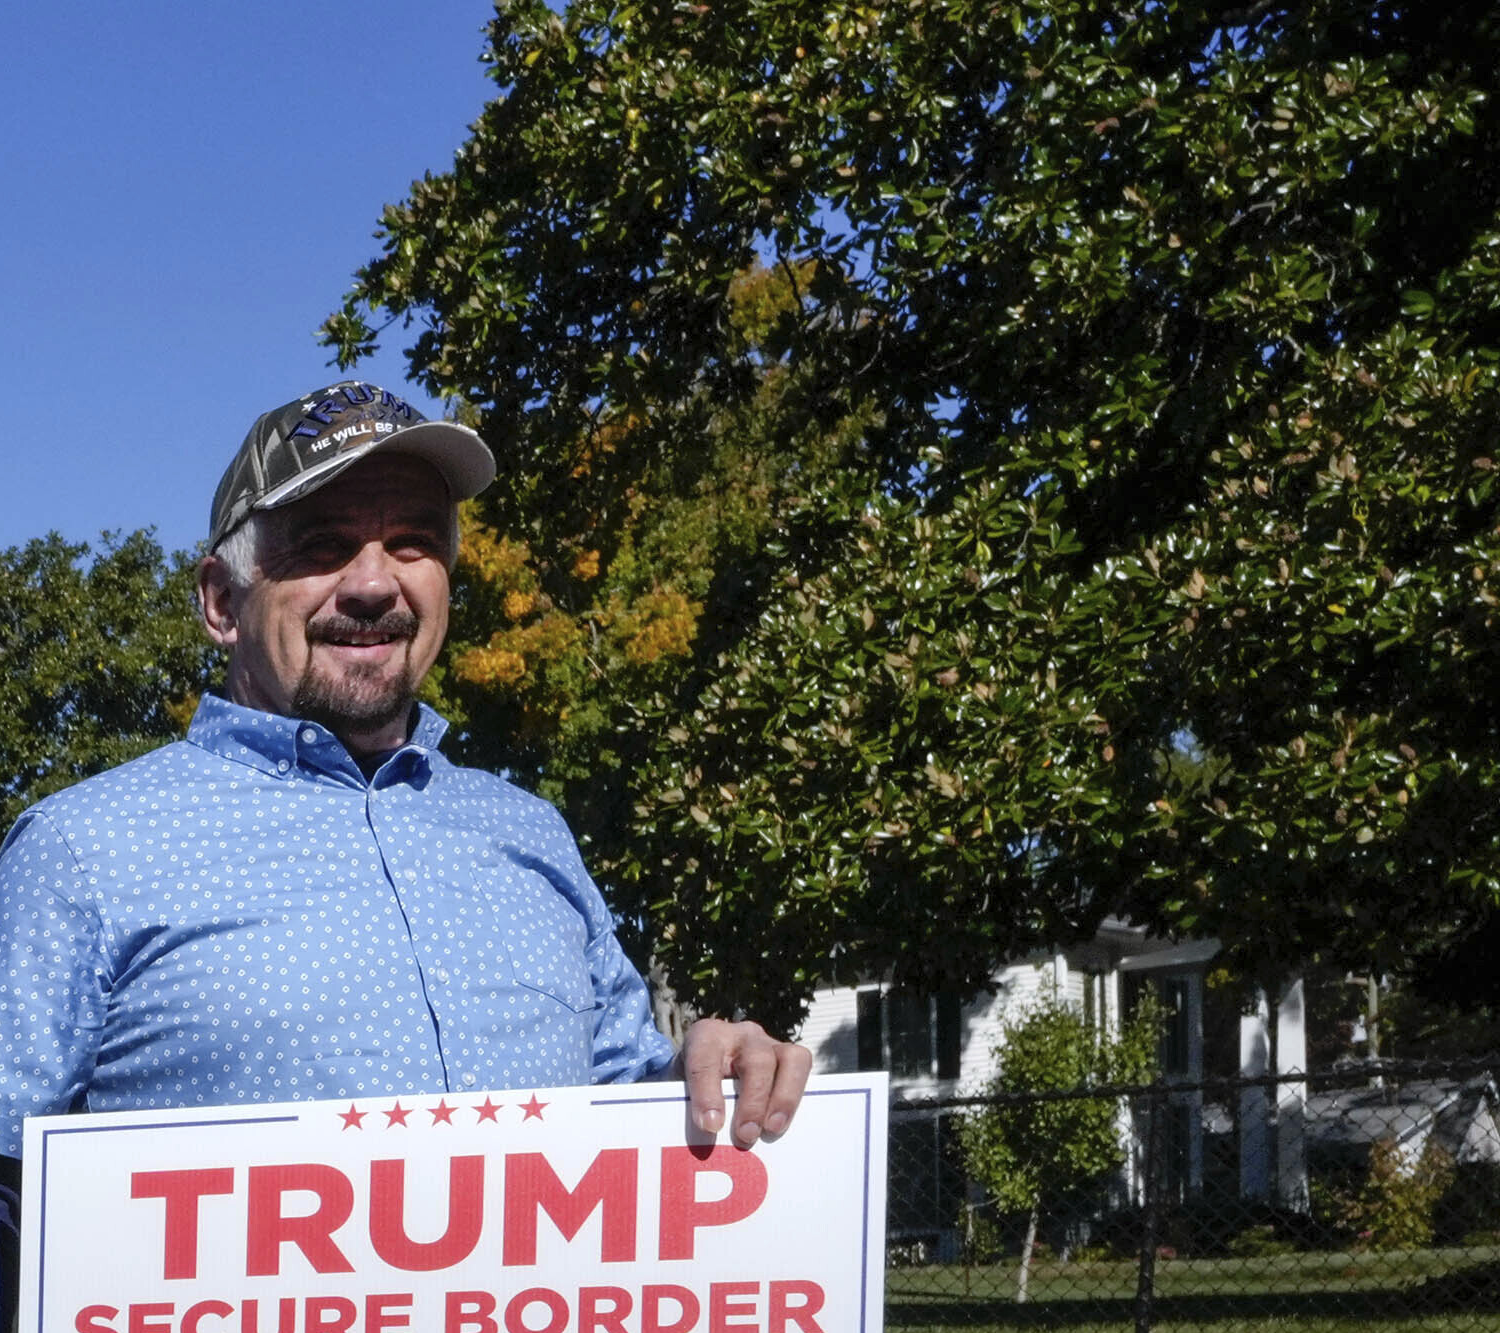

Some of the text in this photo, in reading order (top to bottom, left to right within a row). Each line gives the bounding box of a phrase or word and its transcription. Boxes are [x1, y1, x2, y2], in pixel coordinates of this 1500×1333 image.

[285, 384, 428, 441] TRUM
[311, 437, 331, 452] HE
[333, 424, 371, 442] WILL
[375, 422, 393, 433] BE
[130, 1144, 770, 1280] TRUMP
